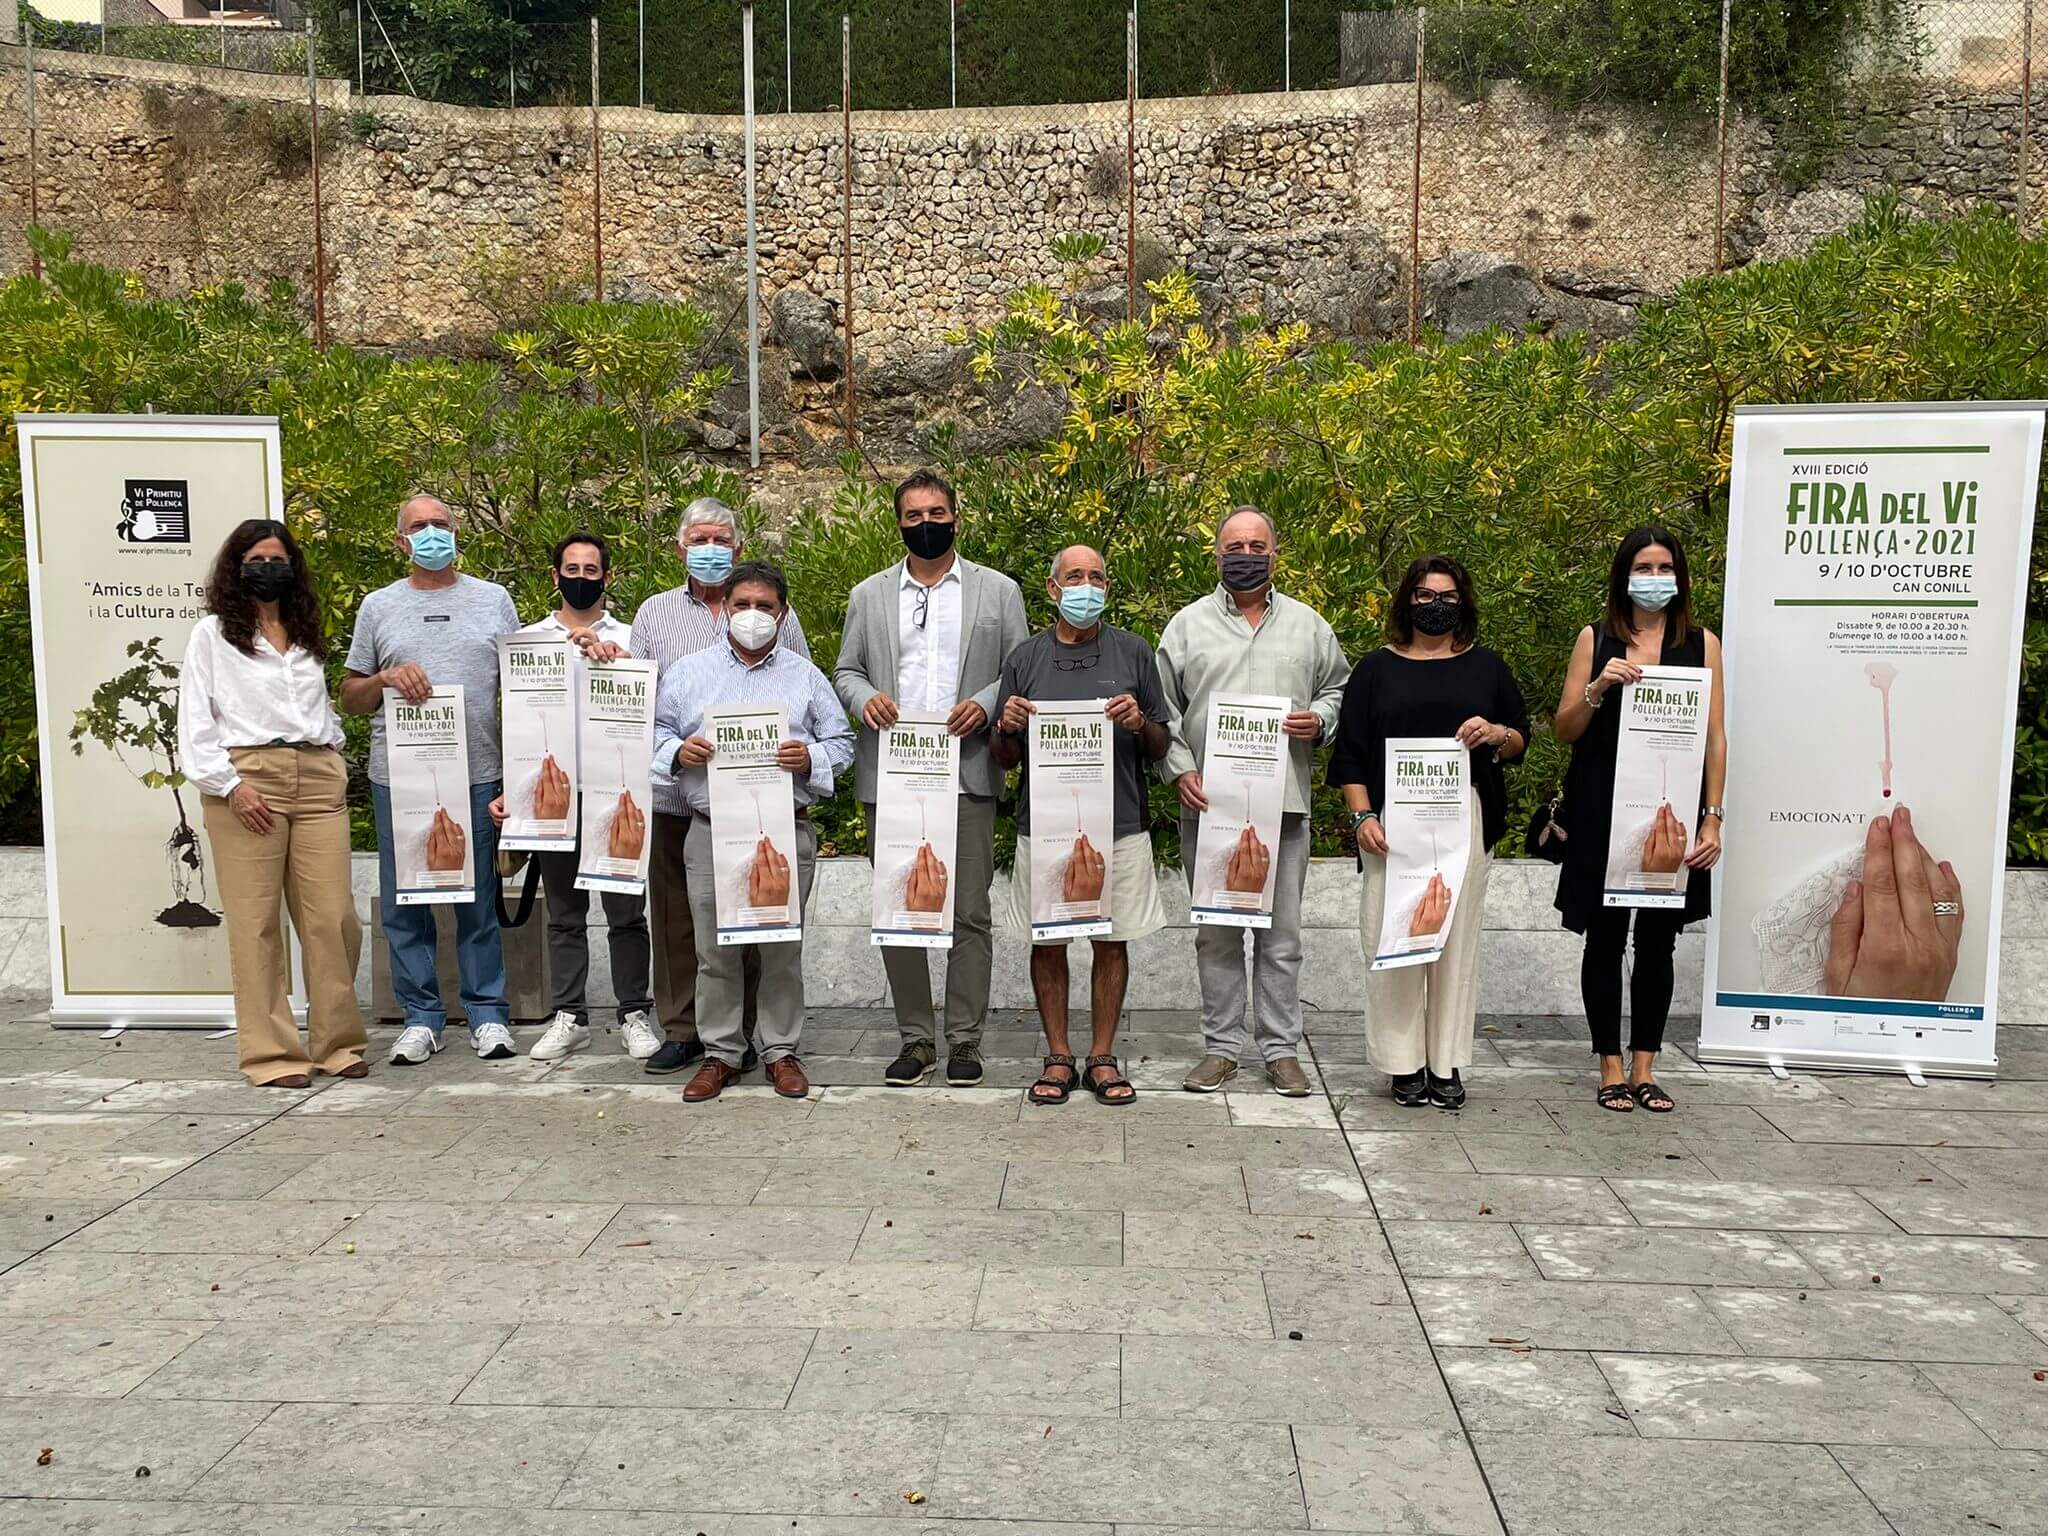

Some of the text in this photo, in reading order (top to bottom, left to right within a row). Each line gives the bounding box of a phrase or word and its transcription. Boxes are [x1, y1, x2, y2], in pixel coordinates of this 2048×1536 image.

[1791, 461, 1869, 476] XVIII EDICIÓ
[1786, 480, 1979, 525] FIRA DEL Vi
[118, 547, 192, 557] www.viprimitiu.org
[1818, 564, 1830, 578] 9
[1847, 564, 1865, 579] 10
[1870, 564, 1973, 578] D'OCTUBRE
[146, 584, 163, 597] de
[167, 584, 180, 597] la
[1892, 582, 1972, 593] CAN CONILL
[97, 605, 110, 618] la
[114, 603, 175, 618] Cultura
[179, 606, 201, 619] del
[1871, 612, 1970, 621] HORARI D'OBERTURA
[1837, 622, 1874, 630] Dissabte
[1885, 622, 1897, 630] de
[1829, 631, 1872, 641] Diumenge
[510, 652, 535, 667] FIRA
[537, 655, 552, 666] DEL
[590, 679, 614, 695] FIRA
[617, 683, 631, 696] DEL
[1634, 687, 1662, 704] FIRA
[1665, 693, 1682, 706] DEL
[396, 706, 422, 721] FIRA
[424, 710, 440, 721] DEL
[1040, 723, 1068, 739] FIRA
[1070, 727, 1088, 739] DEL
[1218, 714, 1245, 731] FIRA
[1247, 720, 1264, 733] DEL
[716, 726, 744, 742] FIRA
[746, 728, 764, 741] DEL
[889, 732, 917, 748] FIRA
[919, 736, 935, 748] DEL
[1397, 761, 1424, 777] FIRA
[1427, 764, 1444, 776] DEL
[1769, 811, 1866, 825] EMOCIONA'T
